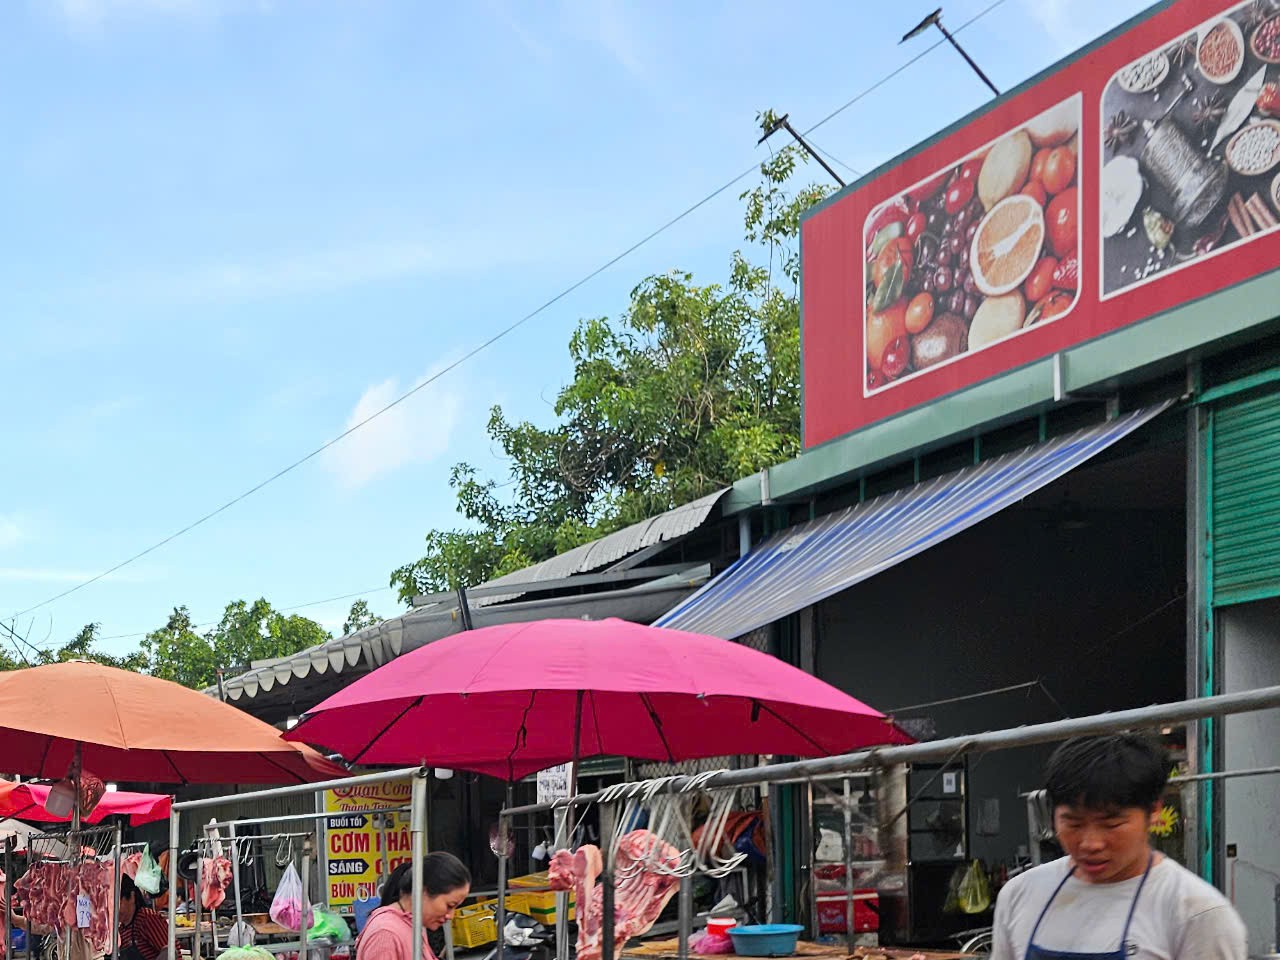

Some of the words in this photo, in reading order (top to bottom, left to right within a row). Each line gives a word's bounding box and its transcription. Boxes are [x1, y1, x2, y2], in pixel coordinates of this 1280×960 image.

[331, 831, 370, 853] CƠM
[329, 860, 363, 874] SÁNG
[331, 880, 355, 898] BÚN
